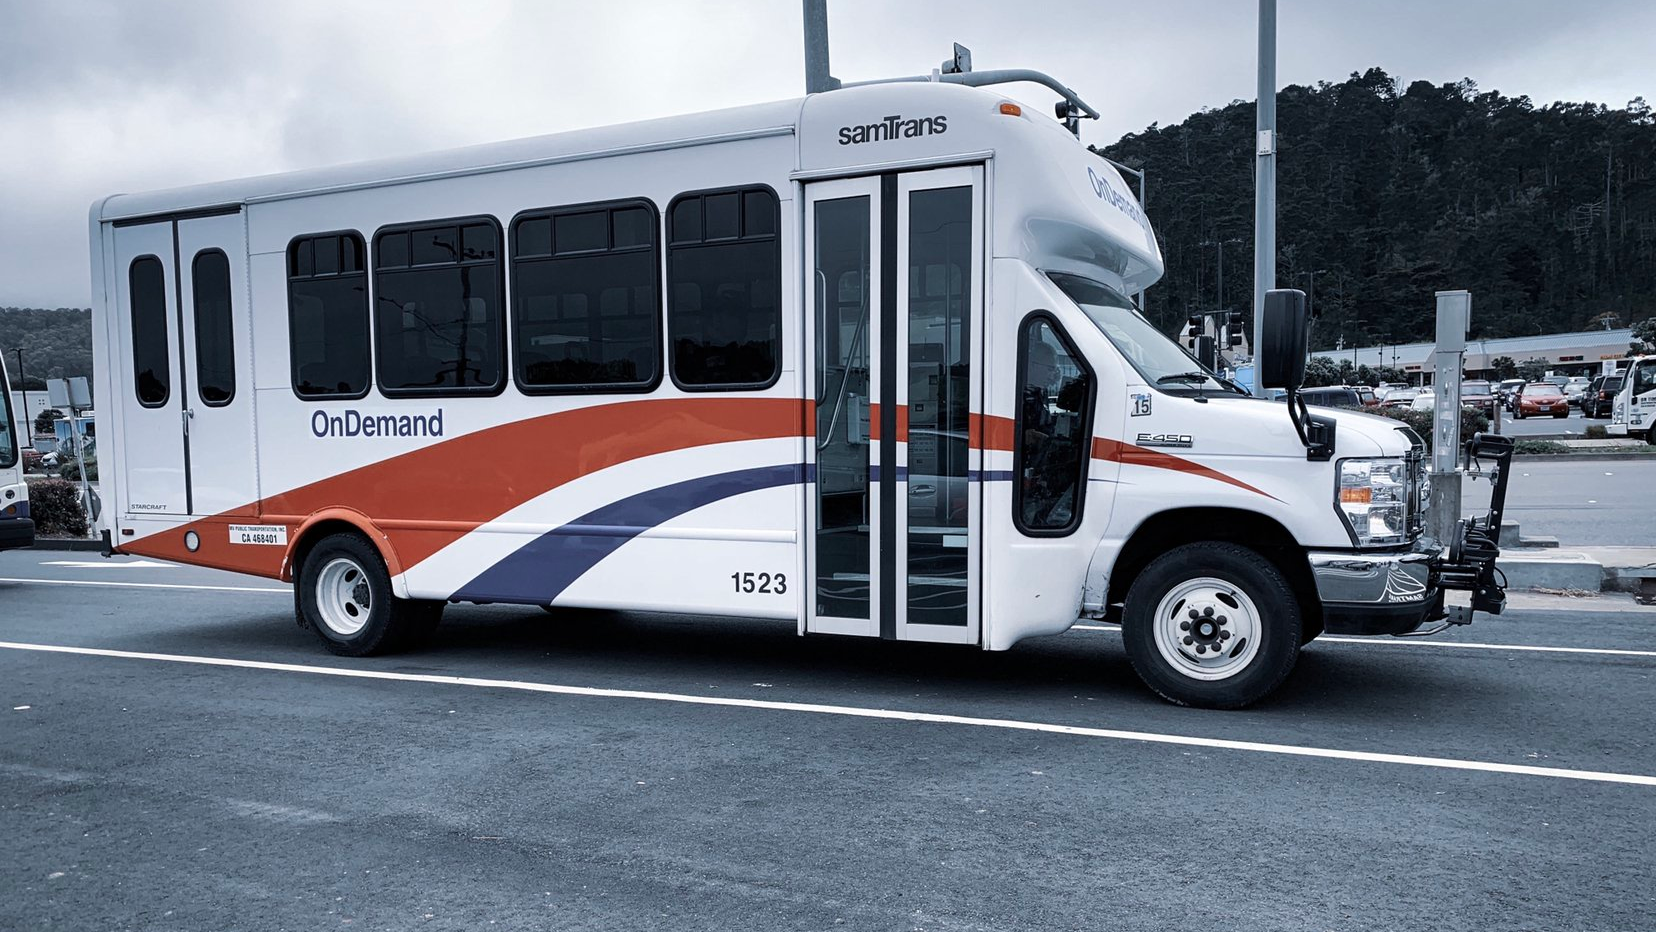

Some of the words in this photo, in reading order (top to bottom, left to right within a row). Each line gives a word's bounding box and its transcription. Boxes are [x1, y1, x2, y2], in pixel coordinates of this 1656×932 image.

[838, 115, 948, 146] samTrans
[1134, 399, 1149, 414] 15
[311, 408, 444, 438] OnDemand
[1136, 433, 1193, 443] E-450
[241, 533, 252, 543] CA
[252, 533, 278, 544] 468401
[731, 571, 787, 595] 1523
